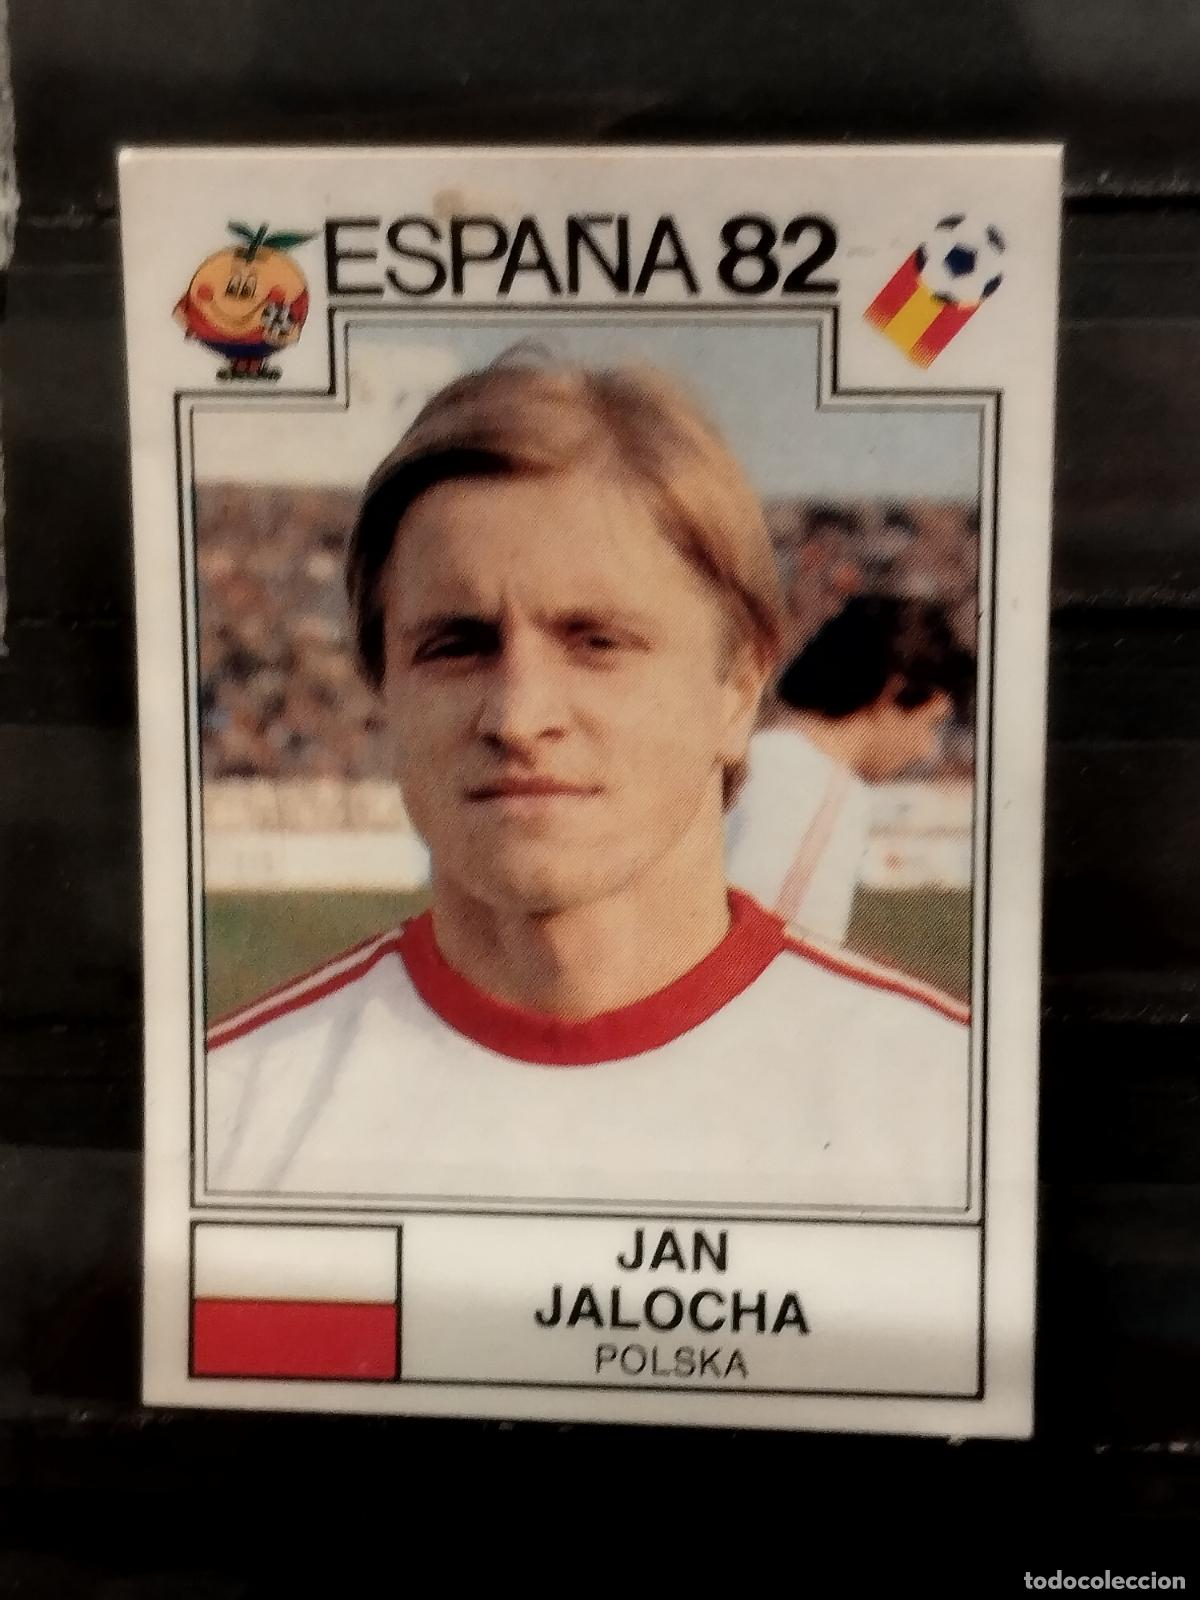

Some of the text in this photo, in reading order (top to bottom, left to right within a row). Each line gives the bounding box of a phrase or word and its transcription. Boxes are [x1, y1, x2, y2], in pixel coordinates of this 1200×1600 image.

[324, 214, 840, 297] ESPAÑA 82
[616, 1228, 729, 1273] JAN
[534, 1284, 811, 1335] JALOCHA
[595, 1343, 749, 1378] POLSKA
